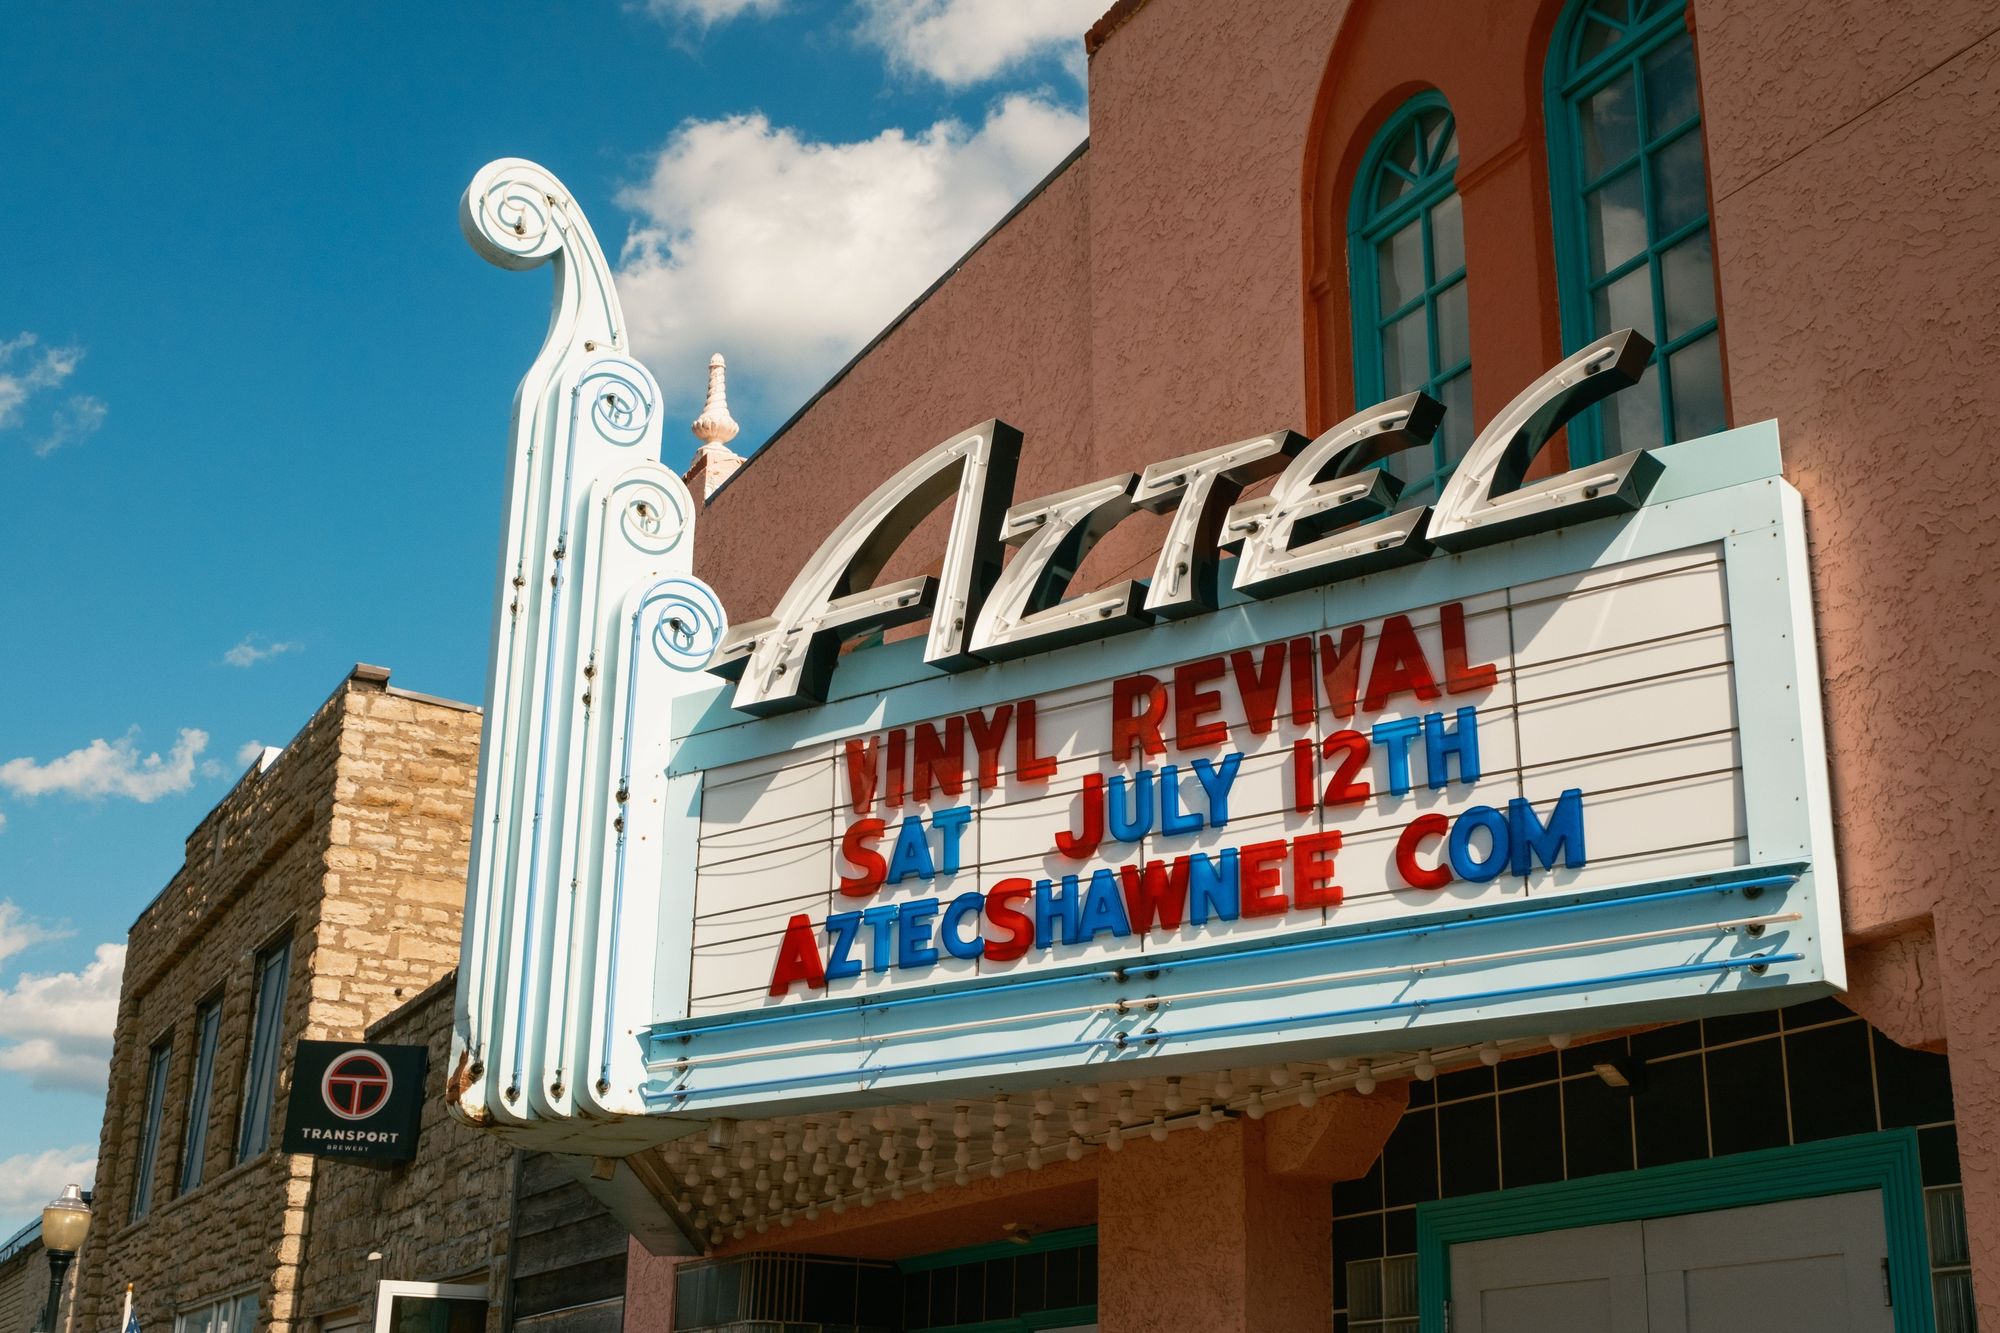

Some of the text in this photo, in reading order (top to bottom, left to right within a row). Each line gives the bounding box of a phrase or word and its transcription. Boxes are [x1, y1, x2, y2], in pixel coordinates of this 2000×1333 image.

[840, 705, 1481, 897] SAT JULY 12TH
[845, 601, 1498, 815] VINYL REVIVAL
[769, 788, 1586, 997] AZTECSHAWNEE COM
[302, 1127, 399, 1144] TRANSPORT
[326, 1144, 369, 1152] BREWERY
